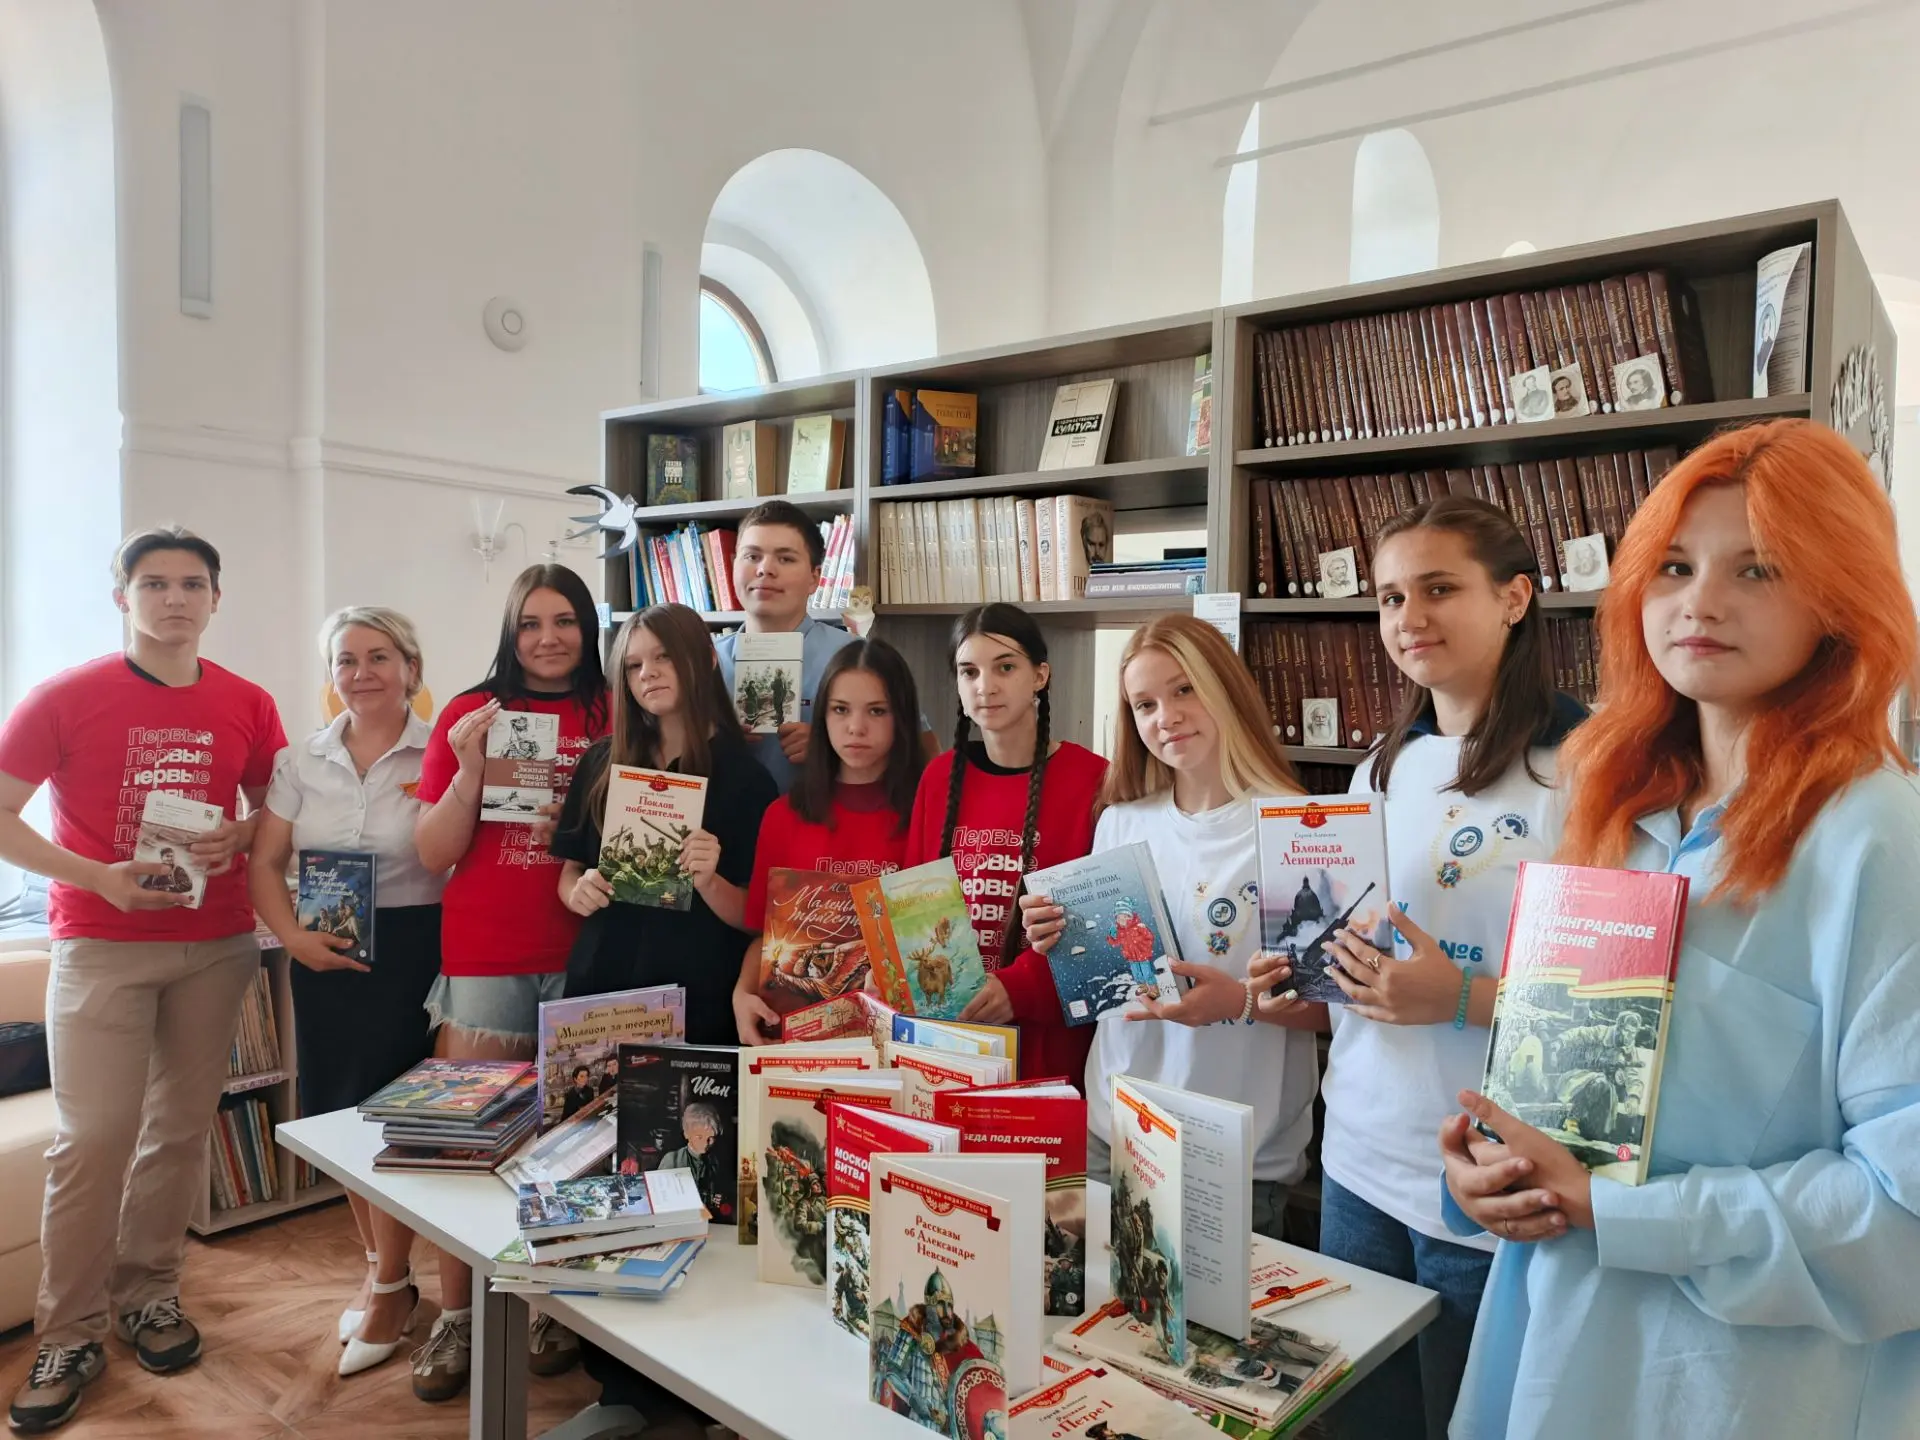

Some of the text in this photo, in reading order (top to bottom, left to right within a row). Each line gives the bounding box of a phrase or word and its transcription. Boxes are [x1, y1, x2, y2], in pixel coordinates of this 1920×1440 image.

[1054, 420, 1098, 435] КУЛЬТУРА
[128, 727, 214, 748] Первые
[126, 747, 213, 769] Первые
[122, 767, 211, 789] Первые
[625, 805, 685, 820] победителям
[639, 795, 675, 810] Поклон
[1308, 806, 1349, 814] Отечественной
[1291, 840, 1343, 856] Блокада
[815, 856, 900, 877] Первые
[1280, 852, 1356, 868] Ленинграда
[1051, 879, 1093, 901] Грустный
[1097, 887, 1121, 900] гном
[1438, 939, 1484, 963] №6
[560, 1014, 672, 1040] Миллион за теорему!
[691, 1075, 731, 1098] Иван
[797, 1091, 822, 1099] Великой
[822, 1093, 868, 1104] Отечественной
[990, 1135, 1012, 1144] ПОД
[1013, 1135, 1062, 1145] КУРСКОМ
[834, 1159, 865, 1184] БИТВА
[890, 1174, 909, 1186] Детям
[916, 1184, 942, 1198] великих
[943, 1192, 963, 1206] людях
[964, 1200, 988, 1214] России
[915, 1214, 961, 1242] Рассказы
[904, 1227, 977, 1261] об Александре
[917, 1242, 959, 1268] Невском
[1059, 1407, 1105, 1432] Петре
